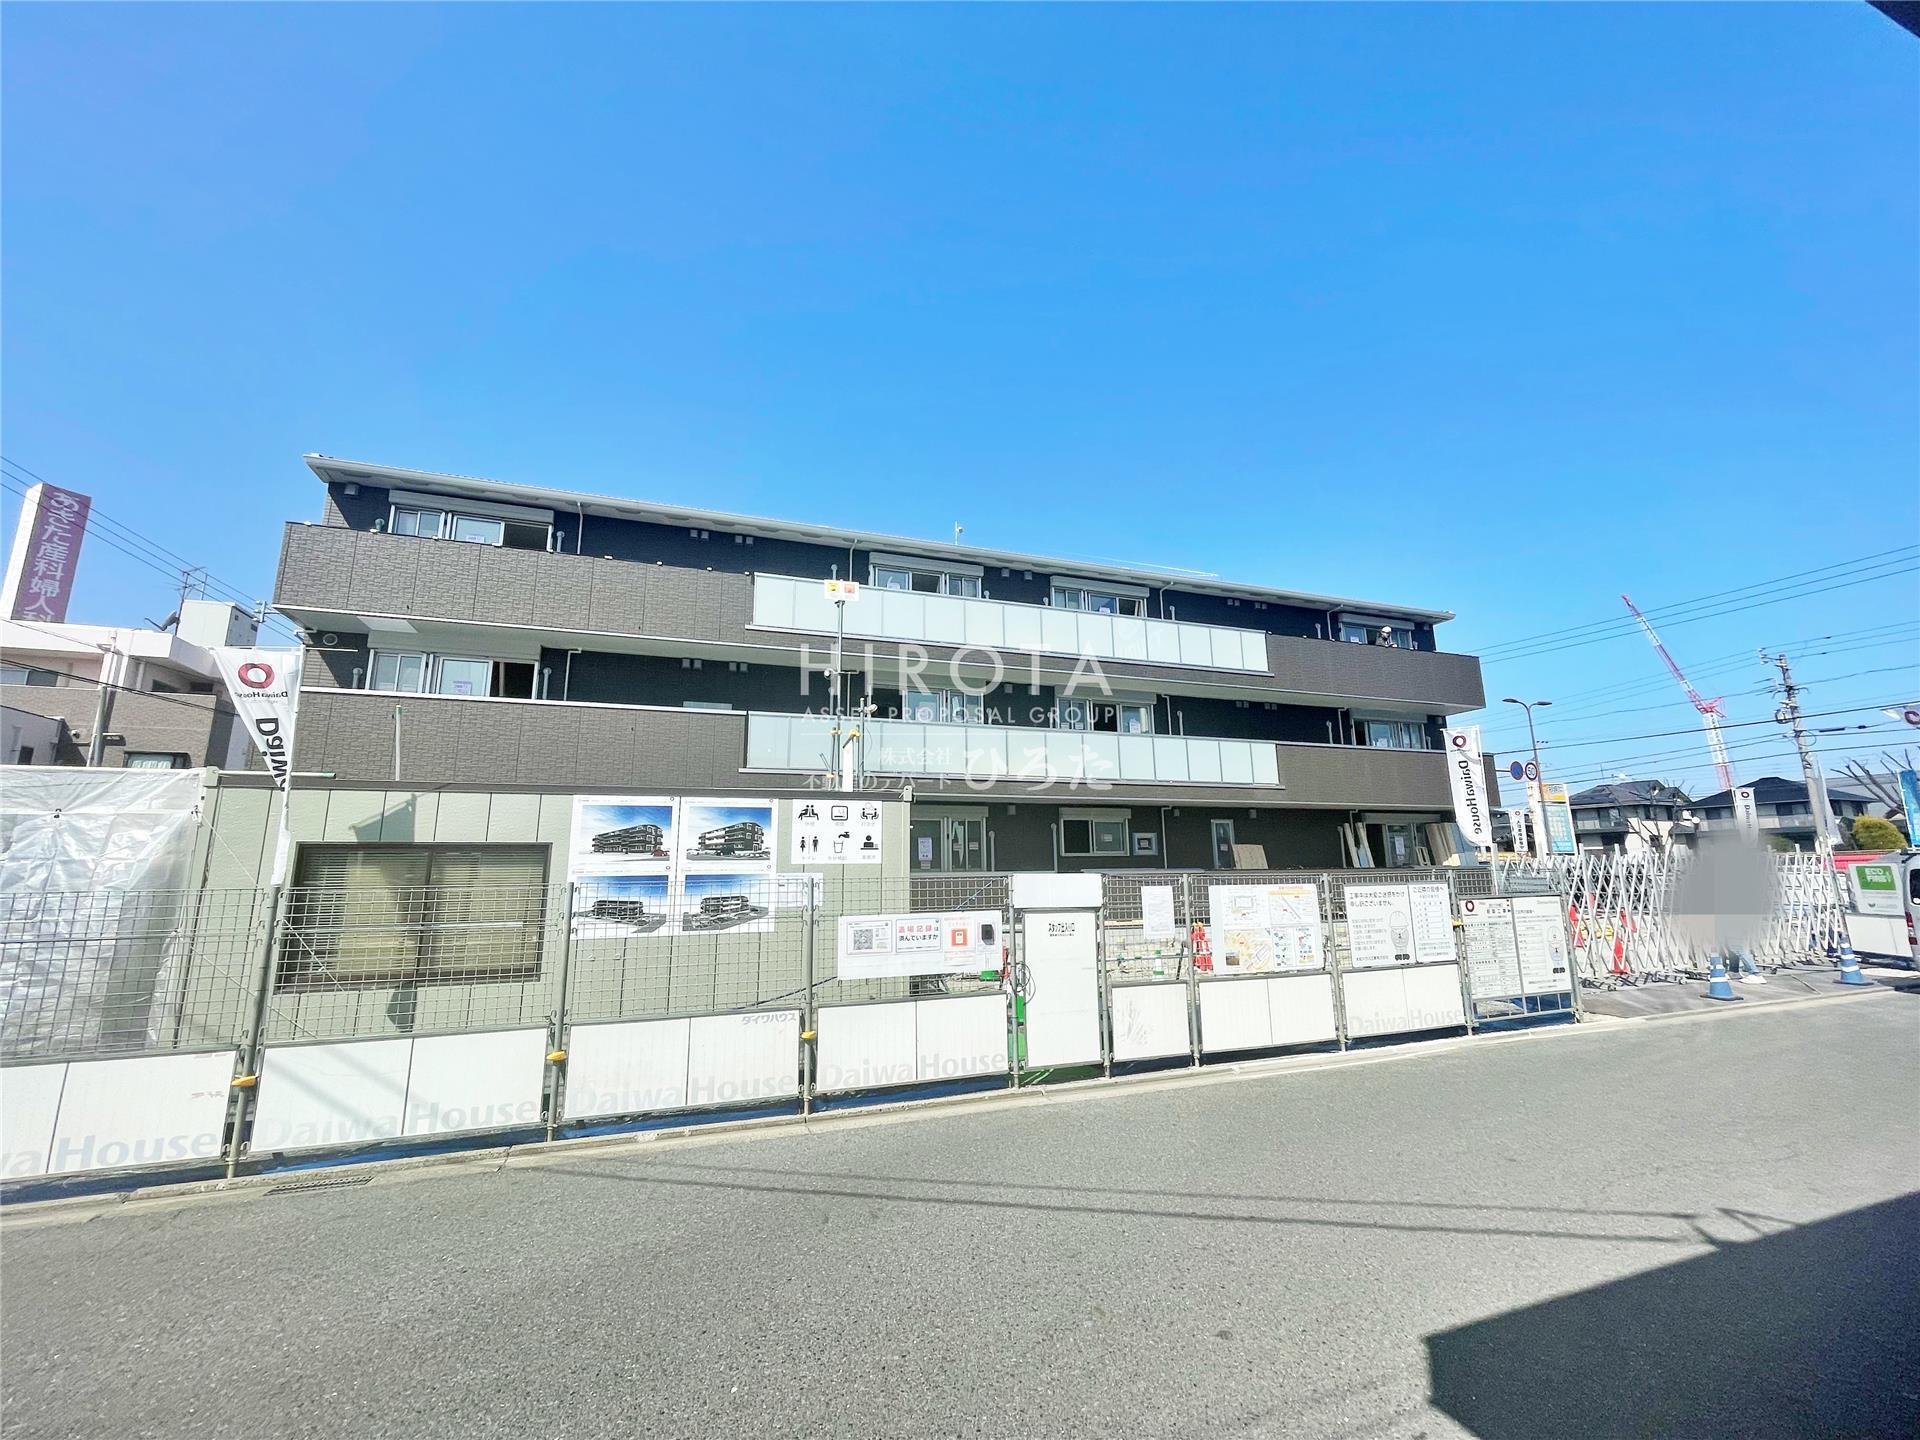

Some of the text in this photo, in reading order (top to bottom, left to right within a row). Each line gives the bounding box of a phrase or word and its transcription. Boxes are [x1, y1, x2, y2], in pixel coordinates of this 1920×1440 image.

[741, 1011, 798, 1025] ダイワハウス
[1349, 1005, 1463, 1032] Daiwa House
[818, 1050, 1007, 1089] Daiwa House
[571, 1072, 796, 1115] Daiwa House
[262, 1098, 537, 1148] Daiwa House
[55, 1132, 218, 1171] House
